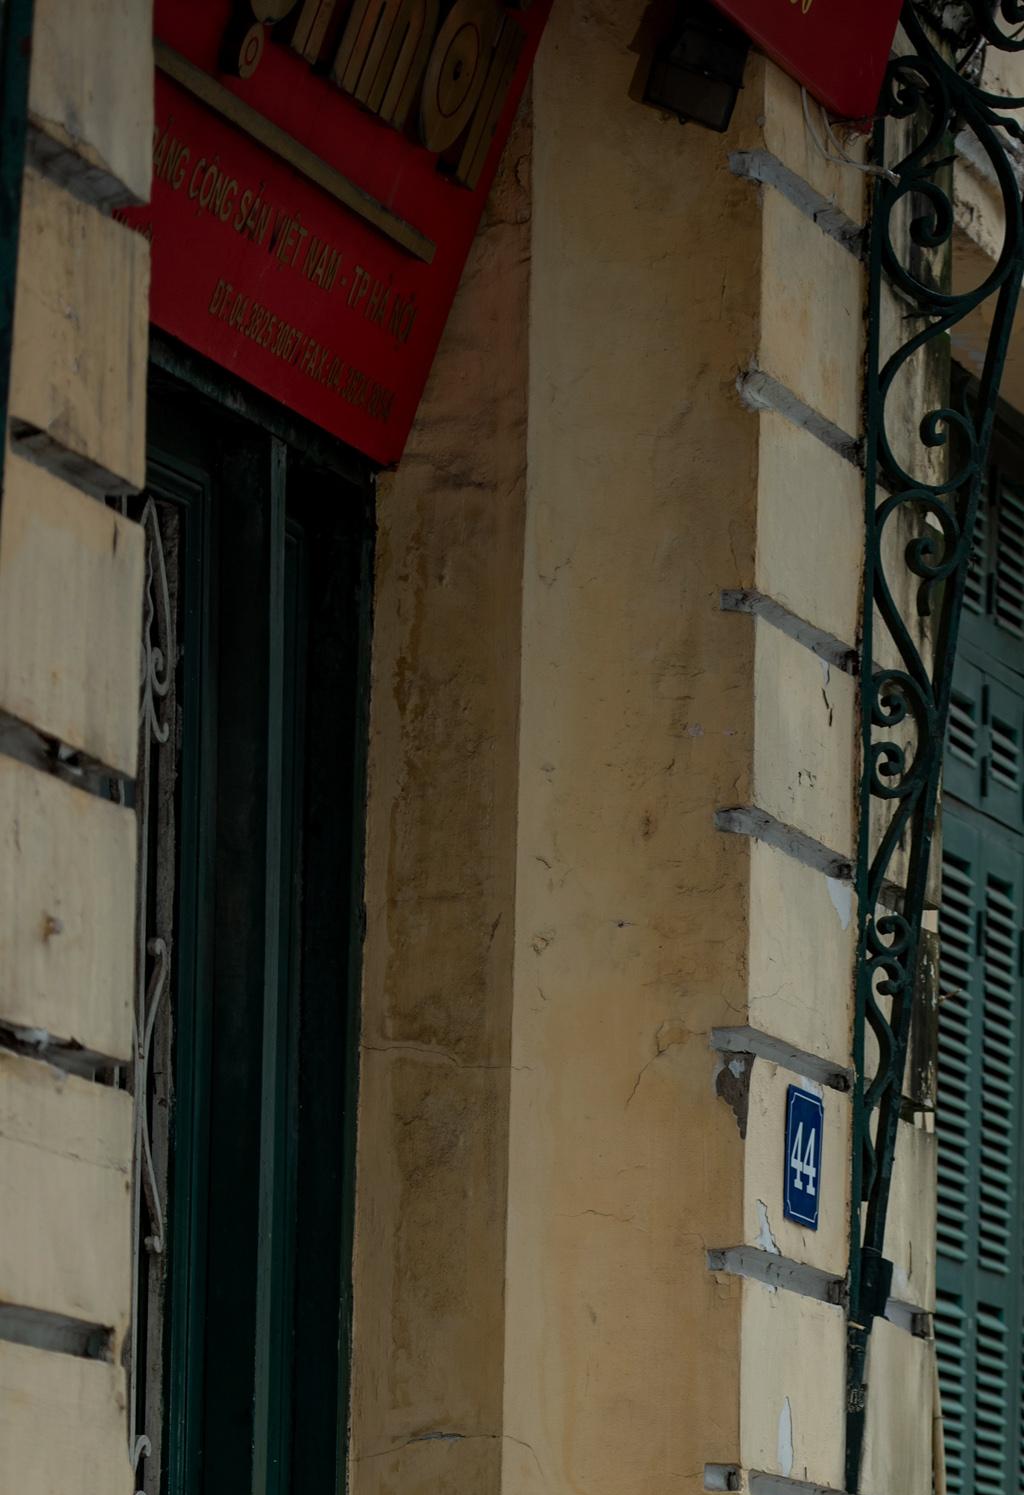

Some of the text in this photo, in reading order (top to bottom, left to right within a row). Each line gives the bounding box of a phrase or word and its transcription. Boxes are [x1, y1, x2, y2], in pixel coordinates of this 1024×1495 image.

[188, 153, 239, 223] CỘNG
[234, 181, 272, 245] SẢN
[268, 209, 309, 271] VIỆT
[303, 236, 343, 292] NAM
[791, 1122, 817, 1195] 44
